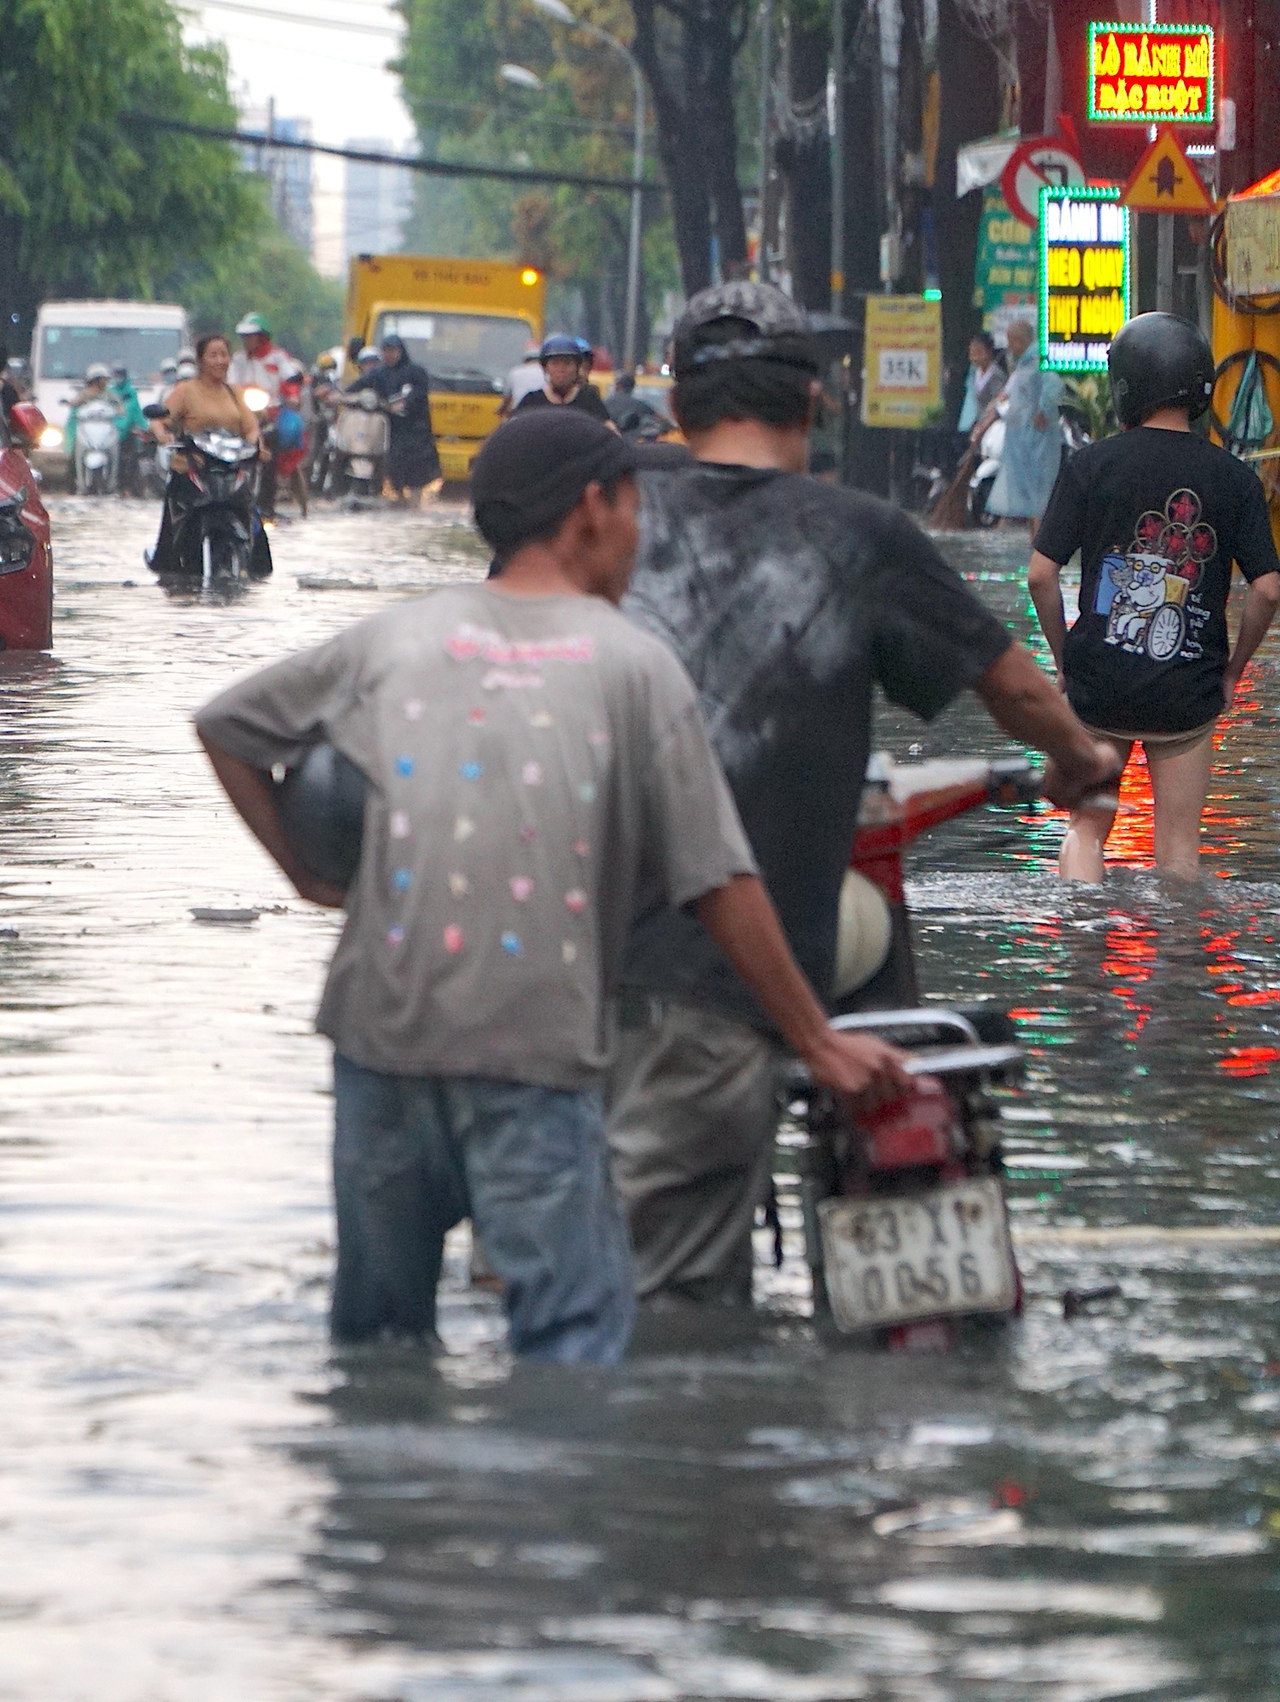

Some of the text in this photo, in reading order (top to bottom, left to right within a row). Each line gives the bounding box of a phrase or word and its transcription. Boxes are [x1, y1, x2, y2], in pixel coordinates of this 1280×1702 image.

[1123, 33, 1181, 77] BÁNH
[1184, 34, 1209, 77] MÌ
[1145, 78, 1202, 115] RUỘT
[1048, 196, 1098, 241] BÁNH
[1048, 247, 1081, 287] HEO
[1083, 247, 1124, 291] QUAY
[1048, 295, 1079, 341] THỊT
